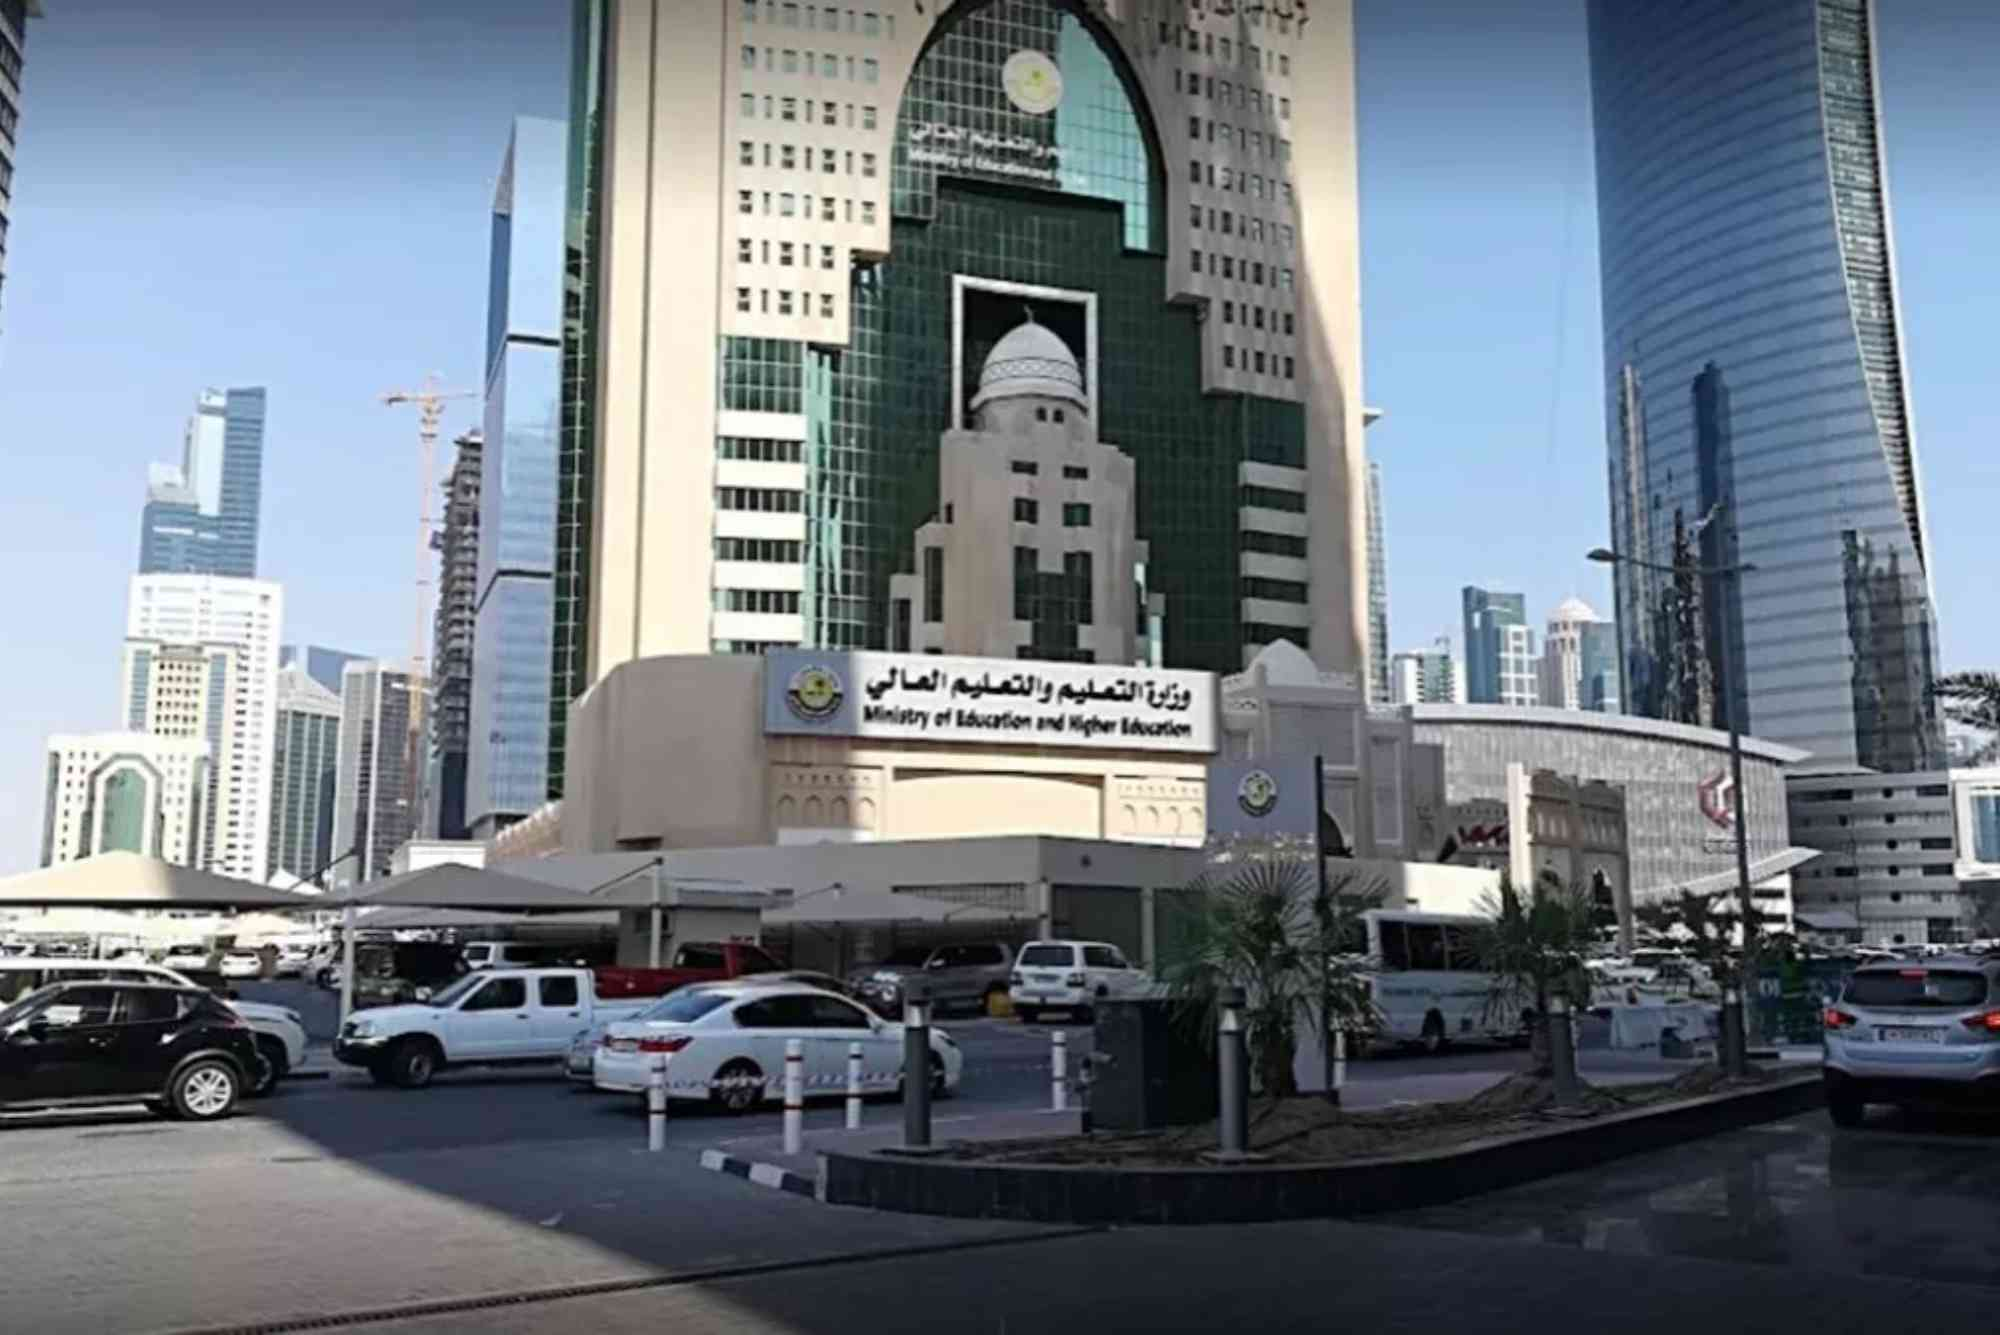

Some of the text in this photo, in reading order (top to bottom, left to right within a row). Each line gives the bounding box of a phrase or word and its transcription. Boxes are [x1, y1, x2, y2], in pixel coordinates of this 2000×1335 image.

[866, 665, 1192, 711] وزارة التعليم والتعليم العالي
[864, 704, 1192, 738] Ministry of Education and Higher Education
